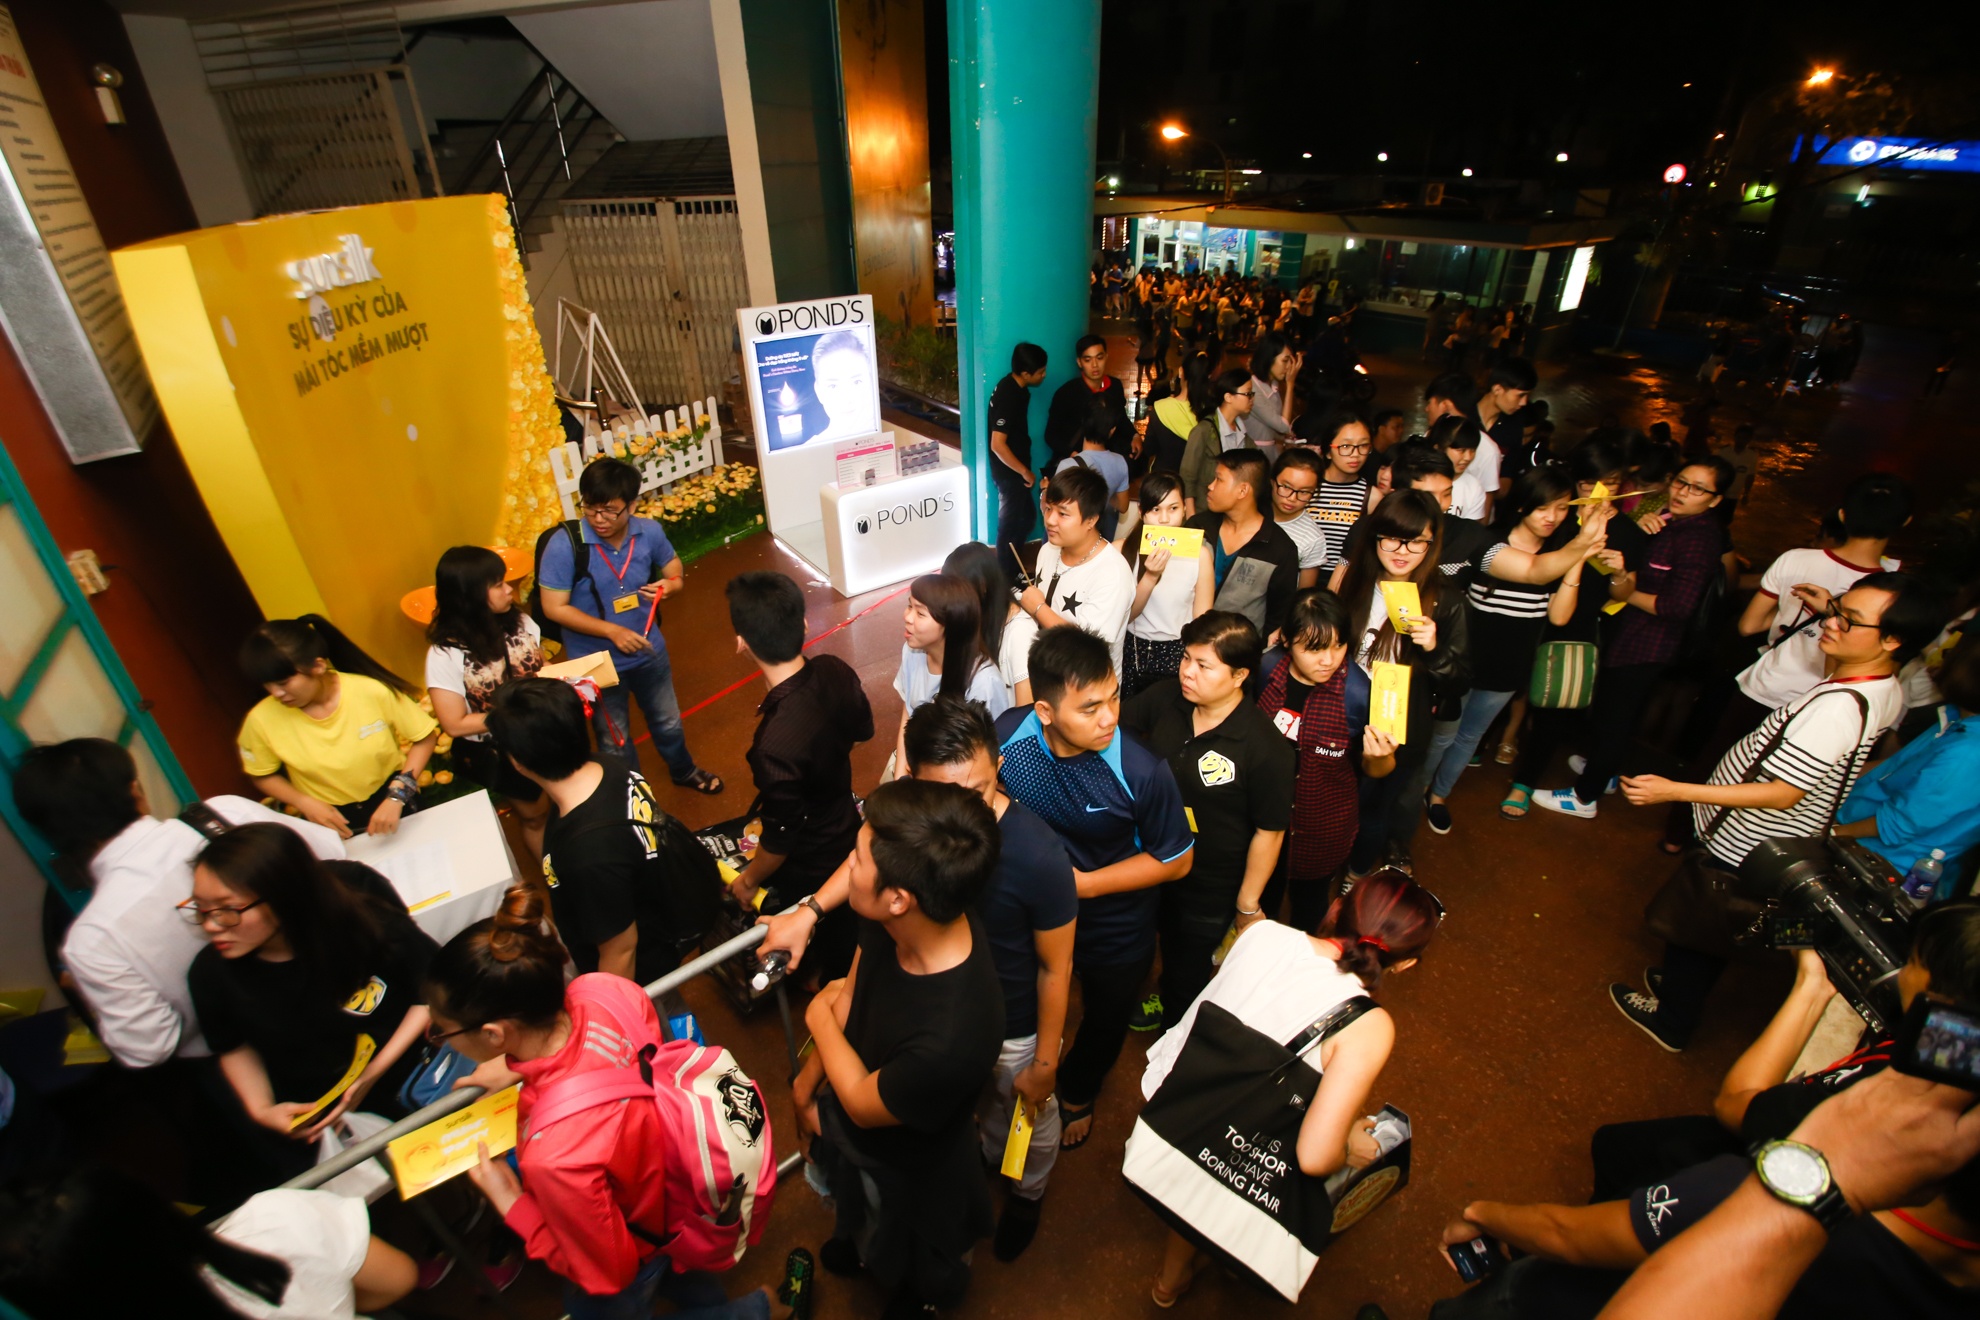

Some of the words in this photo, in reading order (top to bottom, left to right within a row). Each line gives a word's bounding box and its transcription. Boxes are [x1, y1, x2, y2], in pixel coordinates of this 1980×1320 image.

[344, 294, 368, 327] KỲ
[373, 285, 408, 318] CỦA
[779, 300, 864, 333] POND'S
[319, 348, 348, 381] TÓC
[878, 492, 954, 530] POND'S
[1225, 1125, 1252, 1153] TOO
[1267, 1138, 1282, 1153] IS
[1198, 1147, 1247, 1190] BORING
[1247, 1183, 1280, 1213] HAIR
[1238, 1160, 1274, 1187] HAVE
[1652, 1184, 1679, 1223] ck
